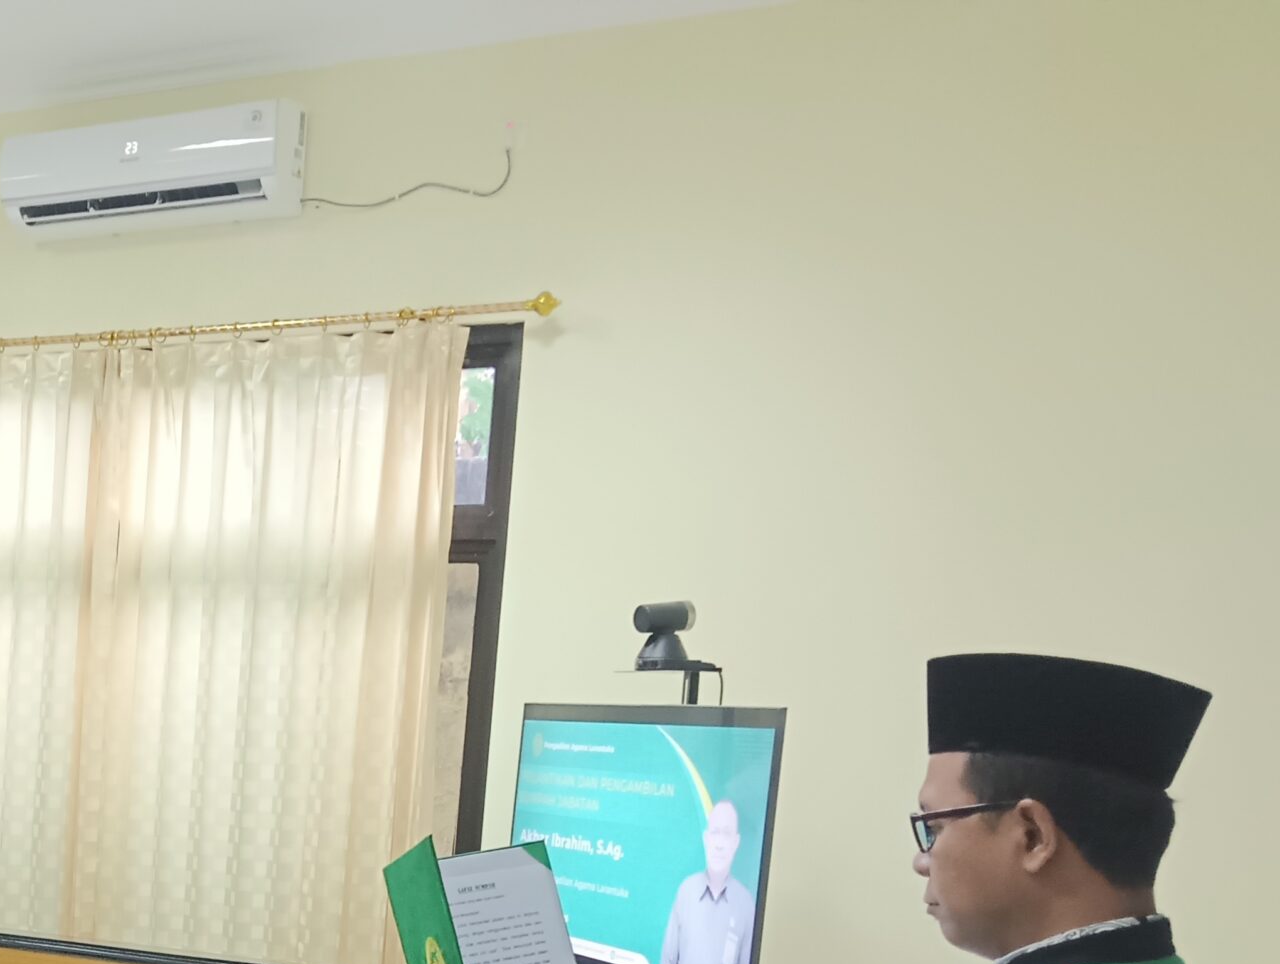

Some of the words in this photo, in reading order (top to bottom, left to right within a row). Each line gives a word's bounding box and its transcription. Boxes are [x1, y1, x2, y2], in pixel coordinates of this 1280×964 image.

[600, 777, 675, 797] PENGAMBILAN
[551, 833, 594, 855] Ibrahim,
[596, 840, 625, 861] S.Ag.
